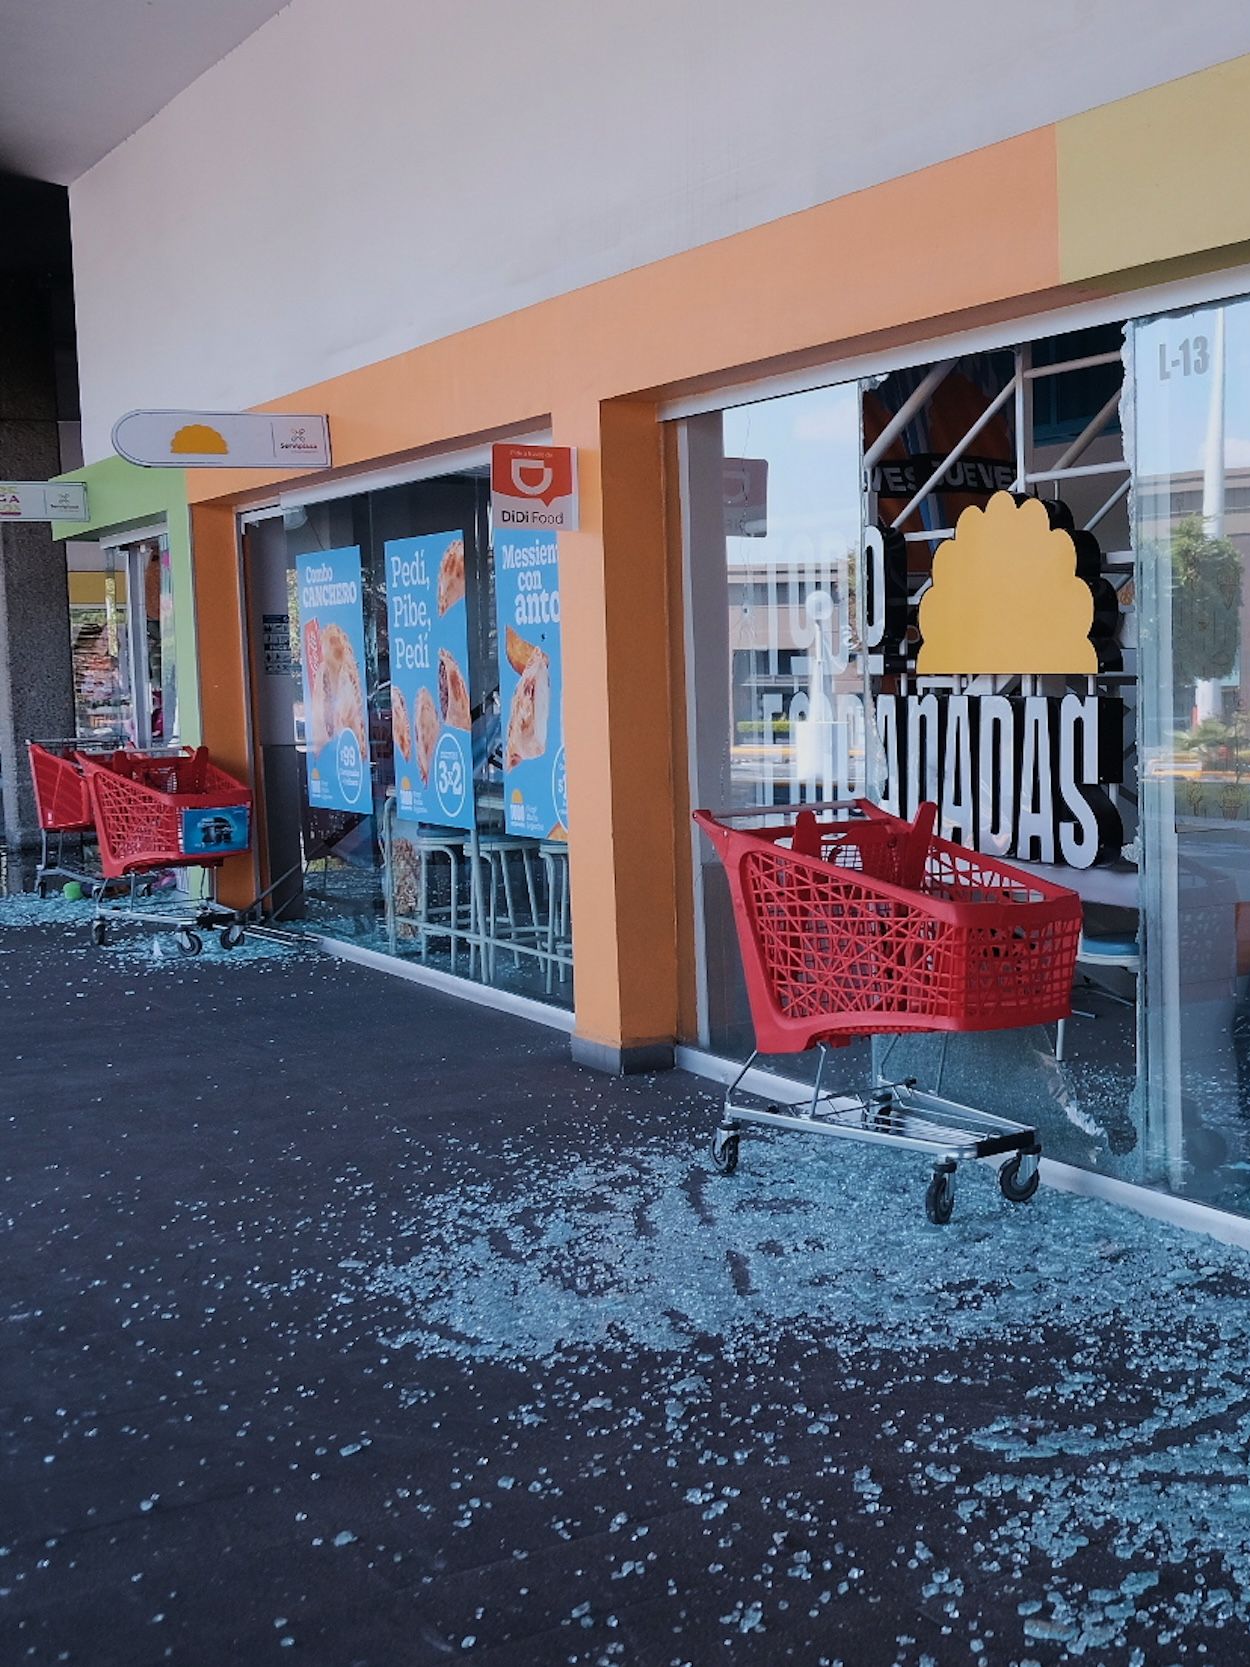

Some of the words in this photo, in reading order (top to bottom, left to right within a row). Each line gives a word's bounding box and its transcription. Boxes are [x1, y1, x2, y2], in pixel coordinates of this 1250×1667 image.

[1159, 335, 1210, 381] L-13
[502, 510, 529, 523] DiDi
[532, 512, 564, 525] Food
[306, 563, 333, 584] Combo
[391, 550, 430, 590] Pedí,
[517, 570, 543, 591] con
[303, 582, 357, 609] CANCHERO
[392, 595, 432, 632] Pibe,
[396, 635, 430, 669] Pedí
